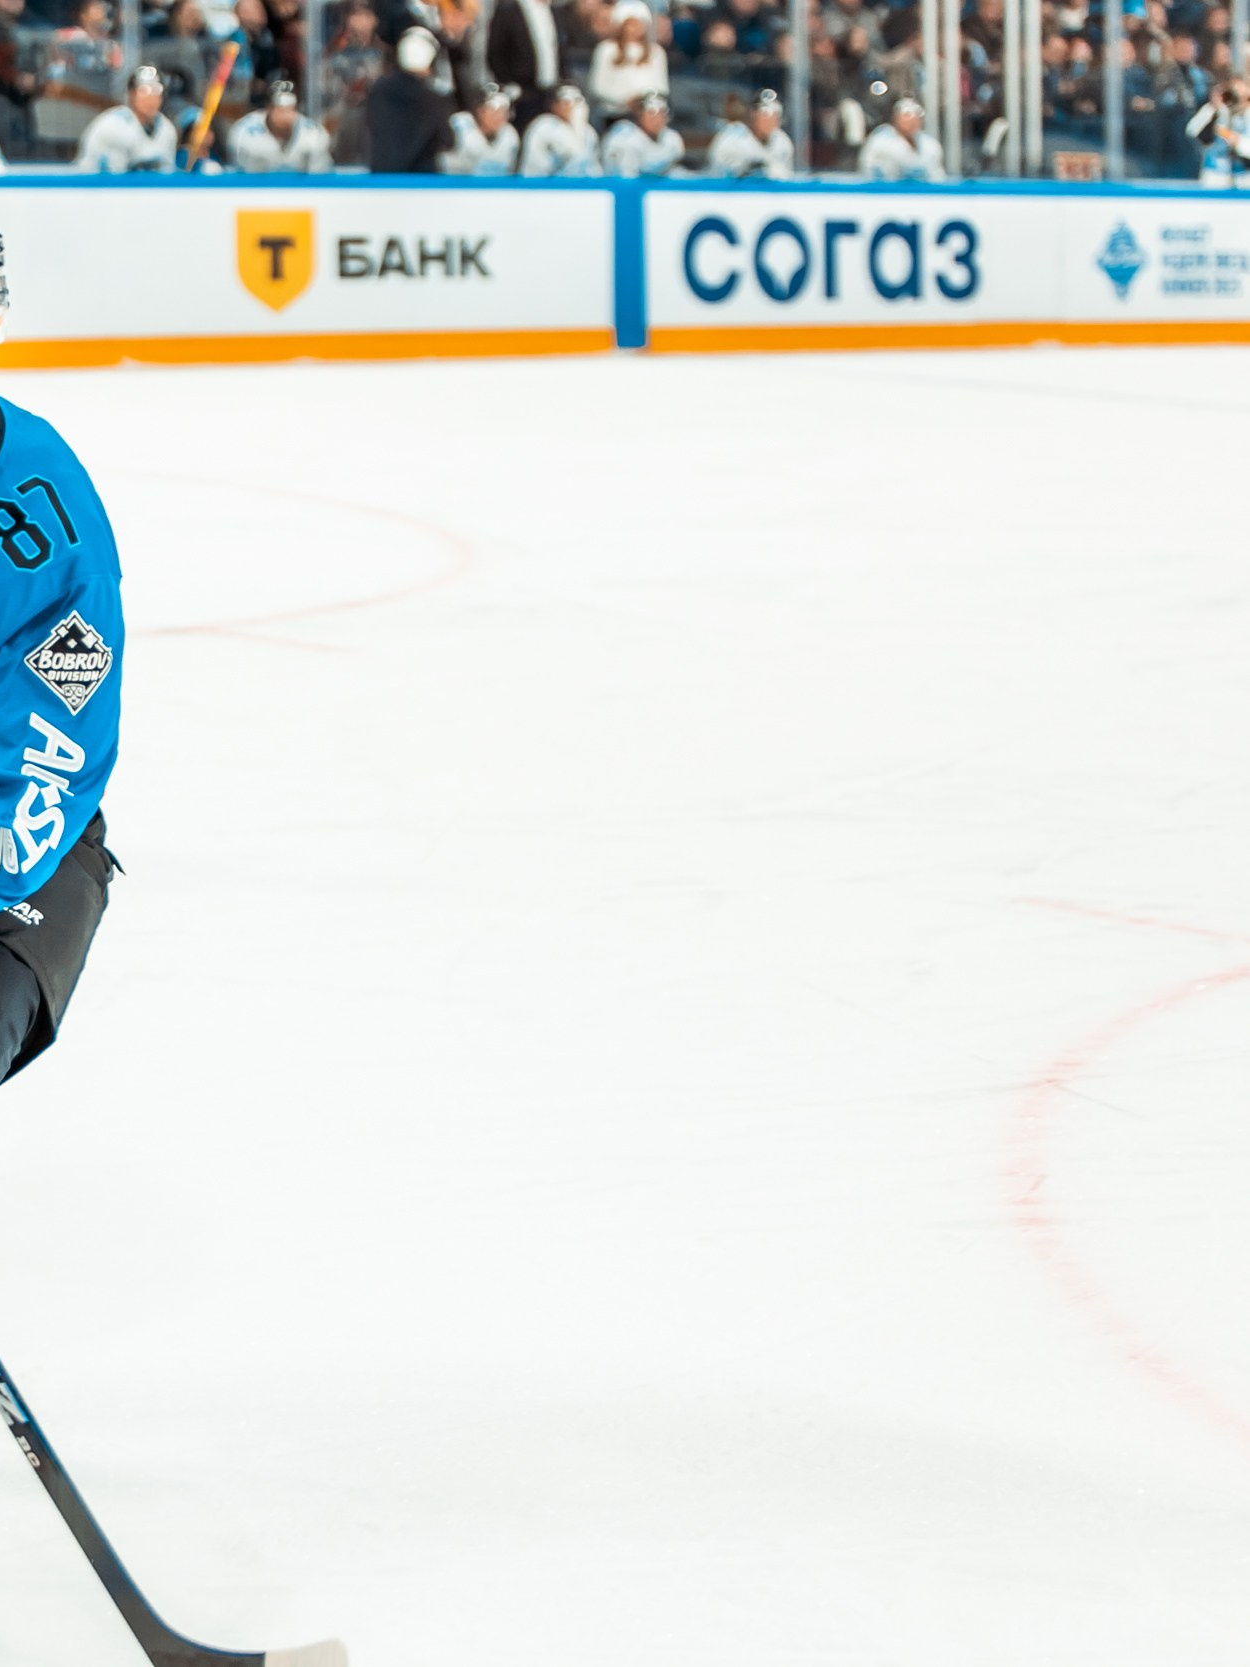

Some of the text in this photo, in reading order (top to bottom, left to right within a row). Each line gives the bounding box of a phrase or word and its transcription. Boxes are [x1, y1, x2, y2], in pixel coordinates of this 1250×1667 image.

[336, 236, 494, 280] БАНК
[38, 649, 109, 671] BOBROV
[46, 670, 100, 682] DIVISION
[12, 901, 44, 926] AR
